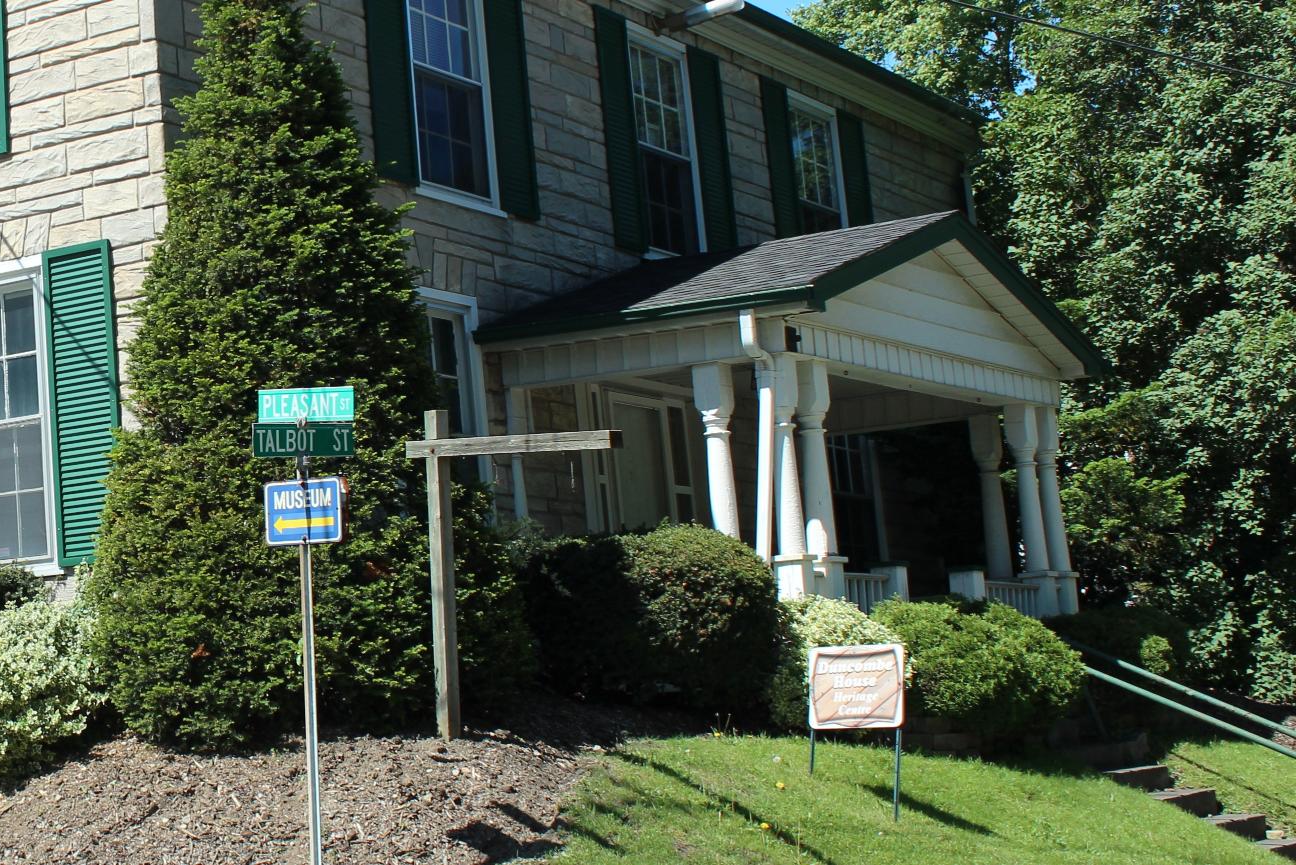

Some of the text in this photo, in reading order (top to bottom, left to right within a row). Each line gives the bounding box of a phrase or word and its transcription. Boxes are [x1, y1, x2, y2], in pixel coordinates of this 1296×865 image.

[262, 393, 351, 417] PLEASANT ST
[256, 429, 350, 453] TALBOT ST
[273, 488, 331, 510] MUSEUM
[832, 676, 878, 689] House
[833, 692, 879, 704] Heritage
